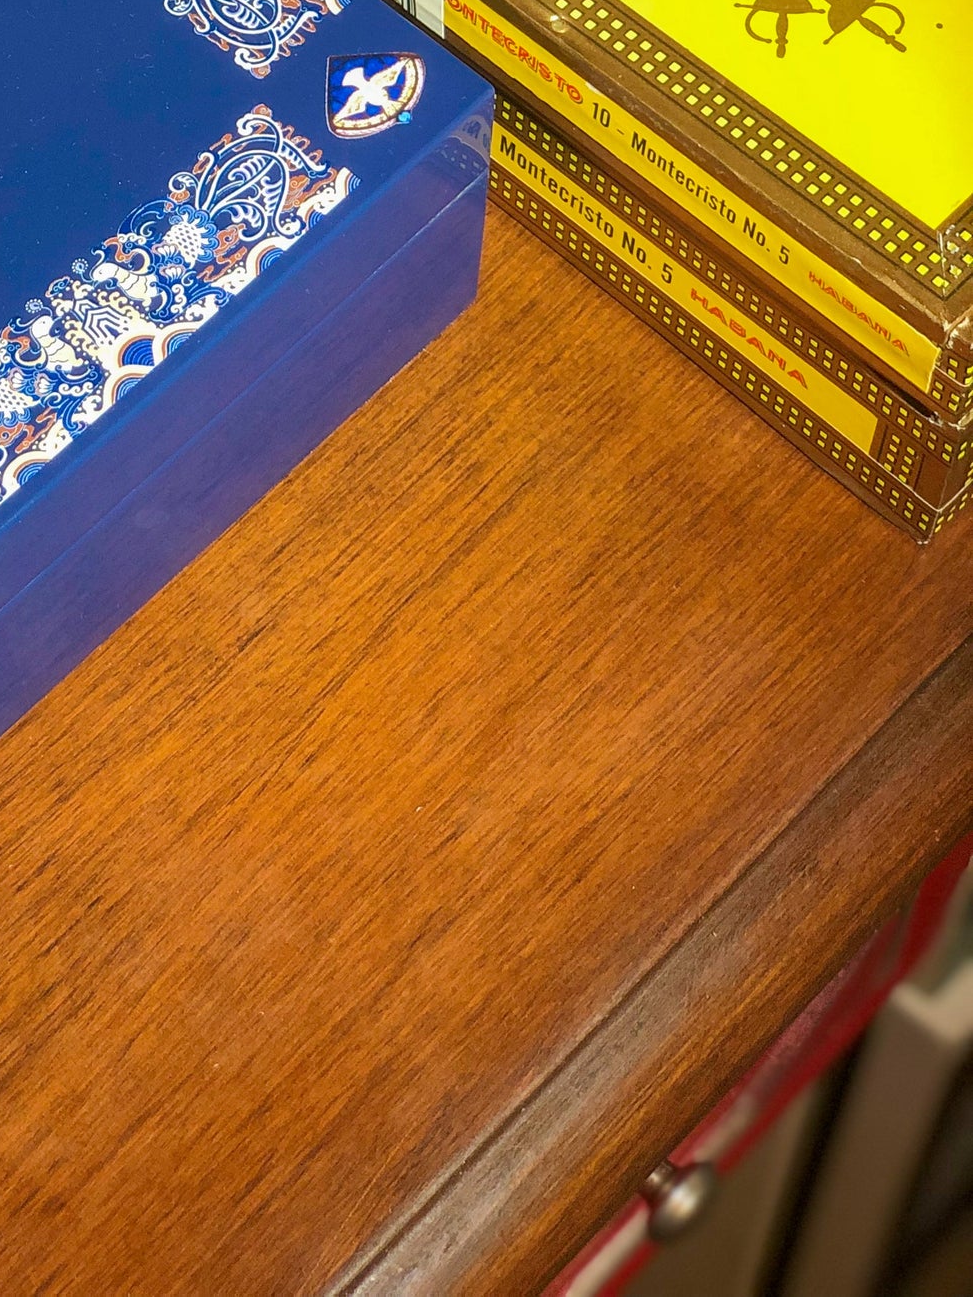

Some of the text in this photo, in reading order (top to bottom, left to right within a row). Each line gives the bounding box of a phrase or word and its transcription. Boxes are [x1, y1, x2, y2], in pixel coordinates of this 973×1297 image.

[499, 133, 808, 391] Montecristo No. 5 HABANA
[592, 102, 611, 128] 10
[631, 130, 737, 227] Montecristo
[742, 214, 771, 255] No.
[778, 245, 791, 266] 5
[808, 270, 911, 357] HABANA
